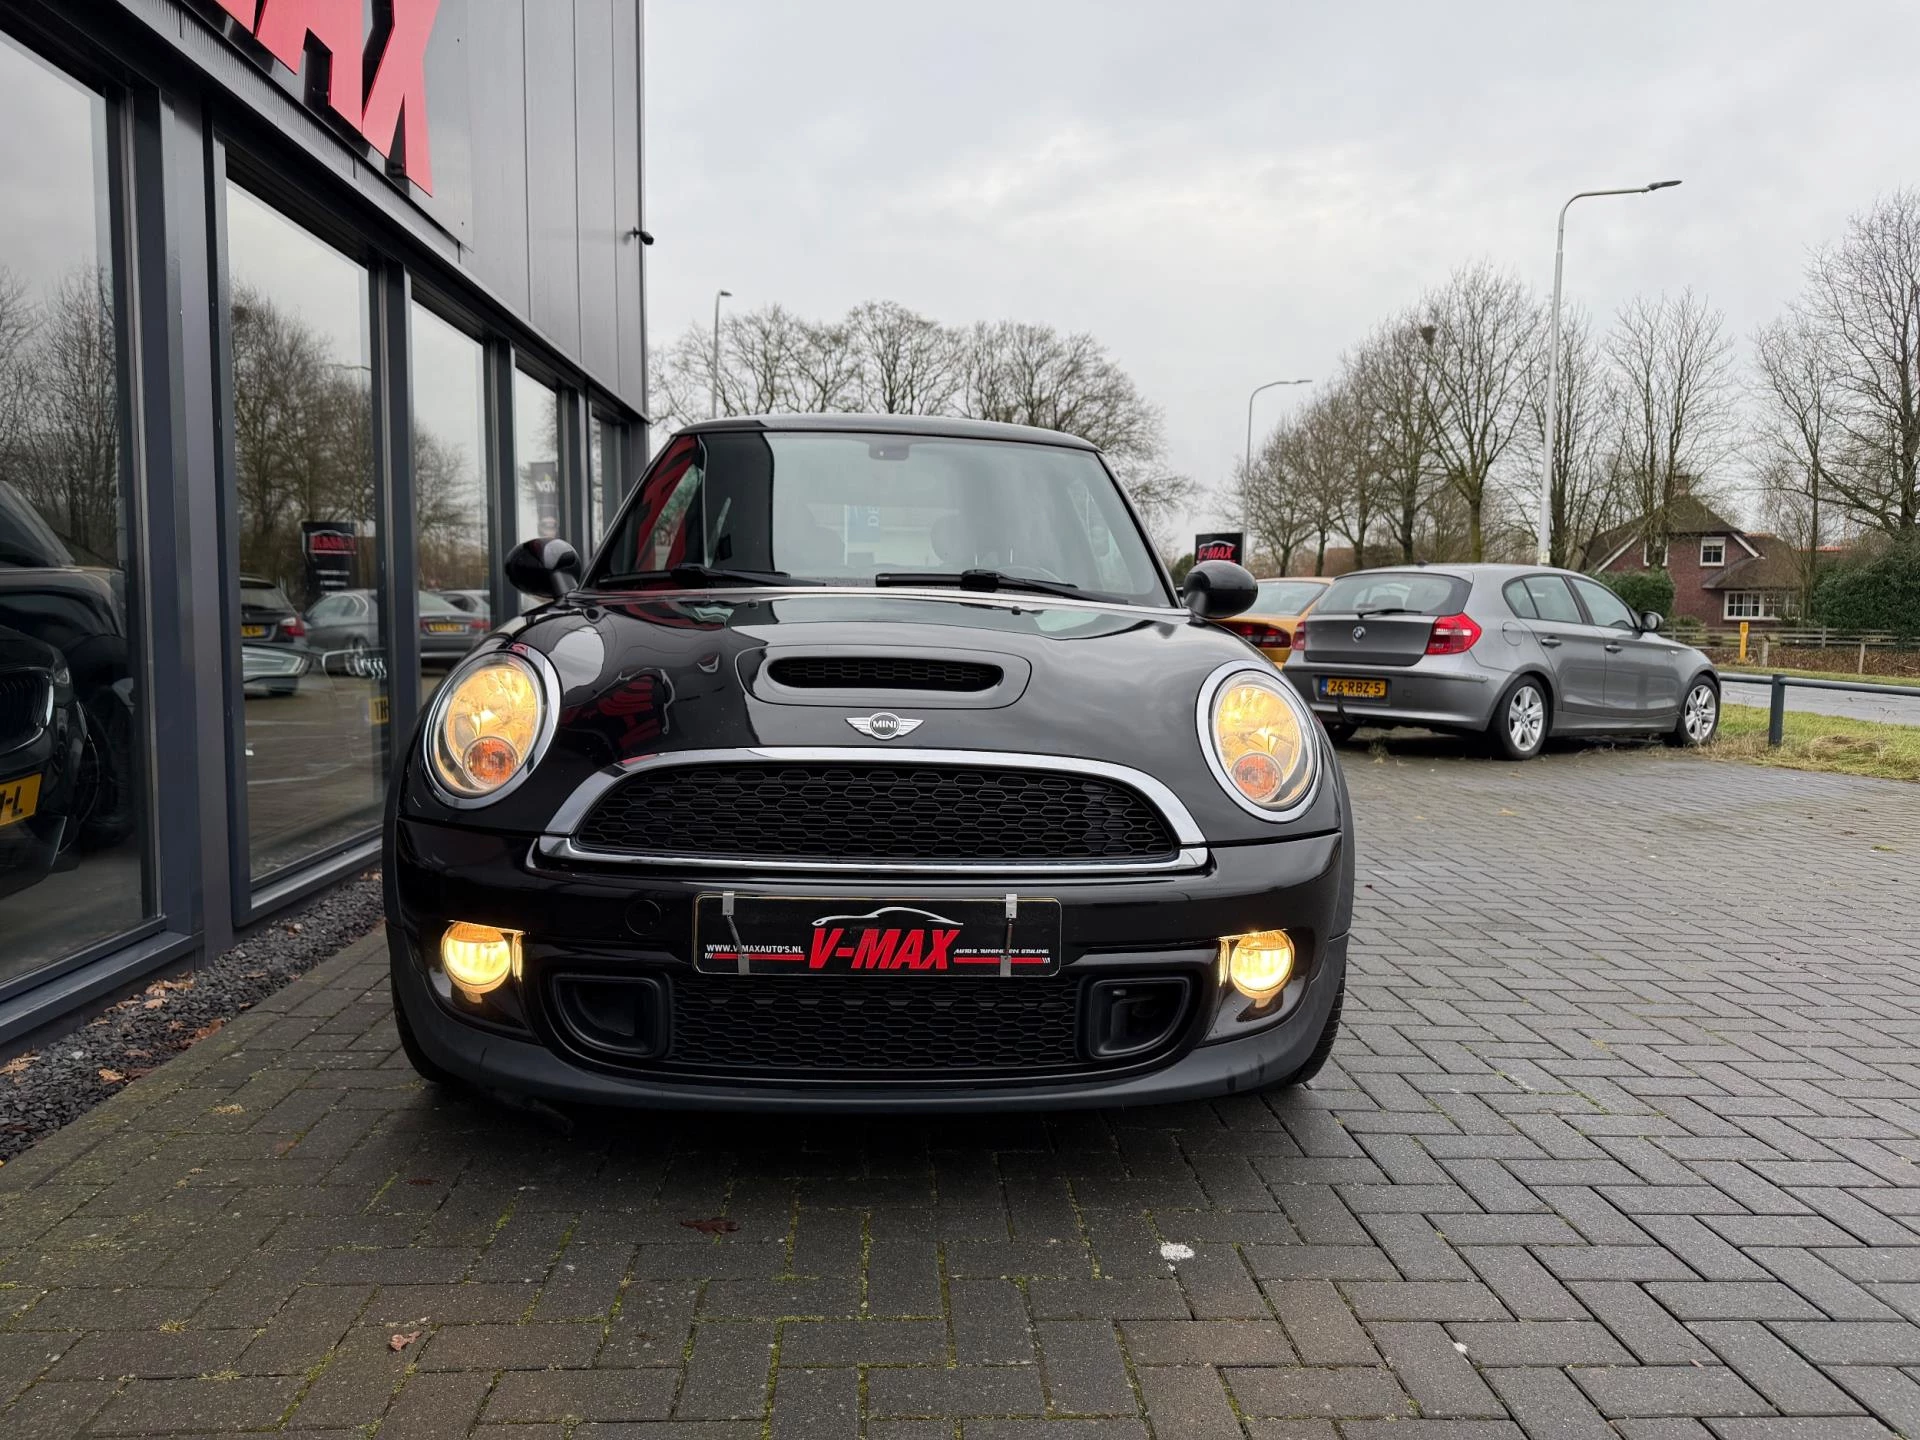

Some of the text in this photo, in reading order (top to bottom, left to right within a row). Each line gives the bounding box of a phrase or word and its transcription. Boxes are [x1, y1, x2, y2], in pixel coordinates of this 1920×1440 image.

[1198, 546, 1235, 560] V-MAX
[1330, 680, 1382, 695] 26-RBZ-5
[873, 720, 897, 728] MINI
[809, 928, 960, 969] V-MAX
